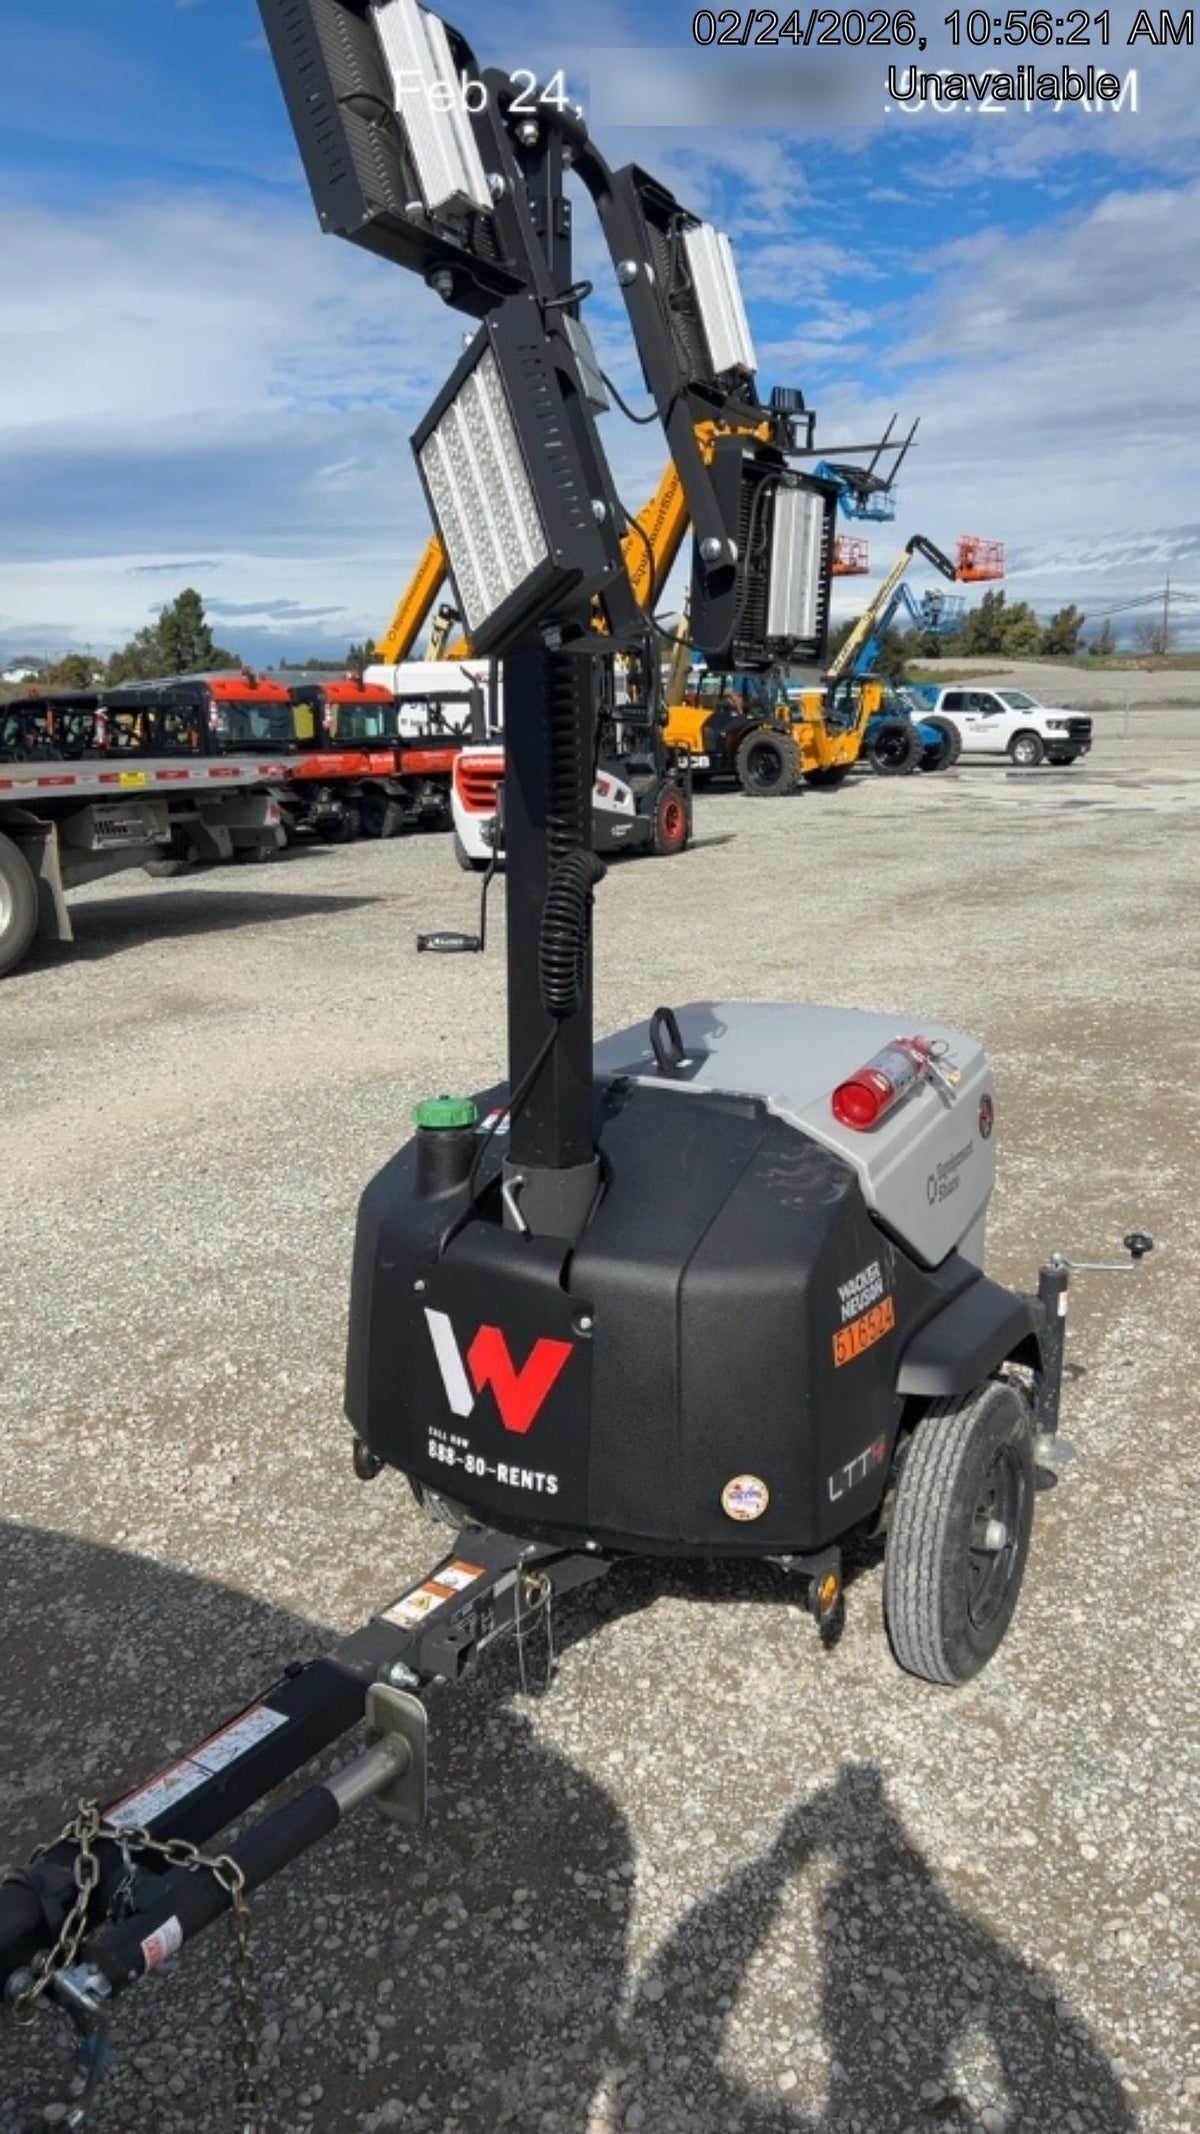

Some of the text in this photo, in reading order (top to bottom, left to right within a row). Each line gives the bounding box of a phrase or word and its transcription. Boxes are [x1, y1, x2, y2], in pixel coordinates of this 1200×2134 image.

[837, 1260, 881, 1303] WACKER
[841, 1277, 884, 1323] NEUSON
[836, 1297, 894, 1363] 516524
[428, 1439, 559, 1495] 888-80-RENTS
